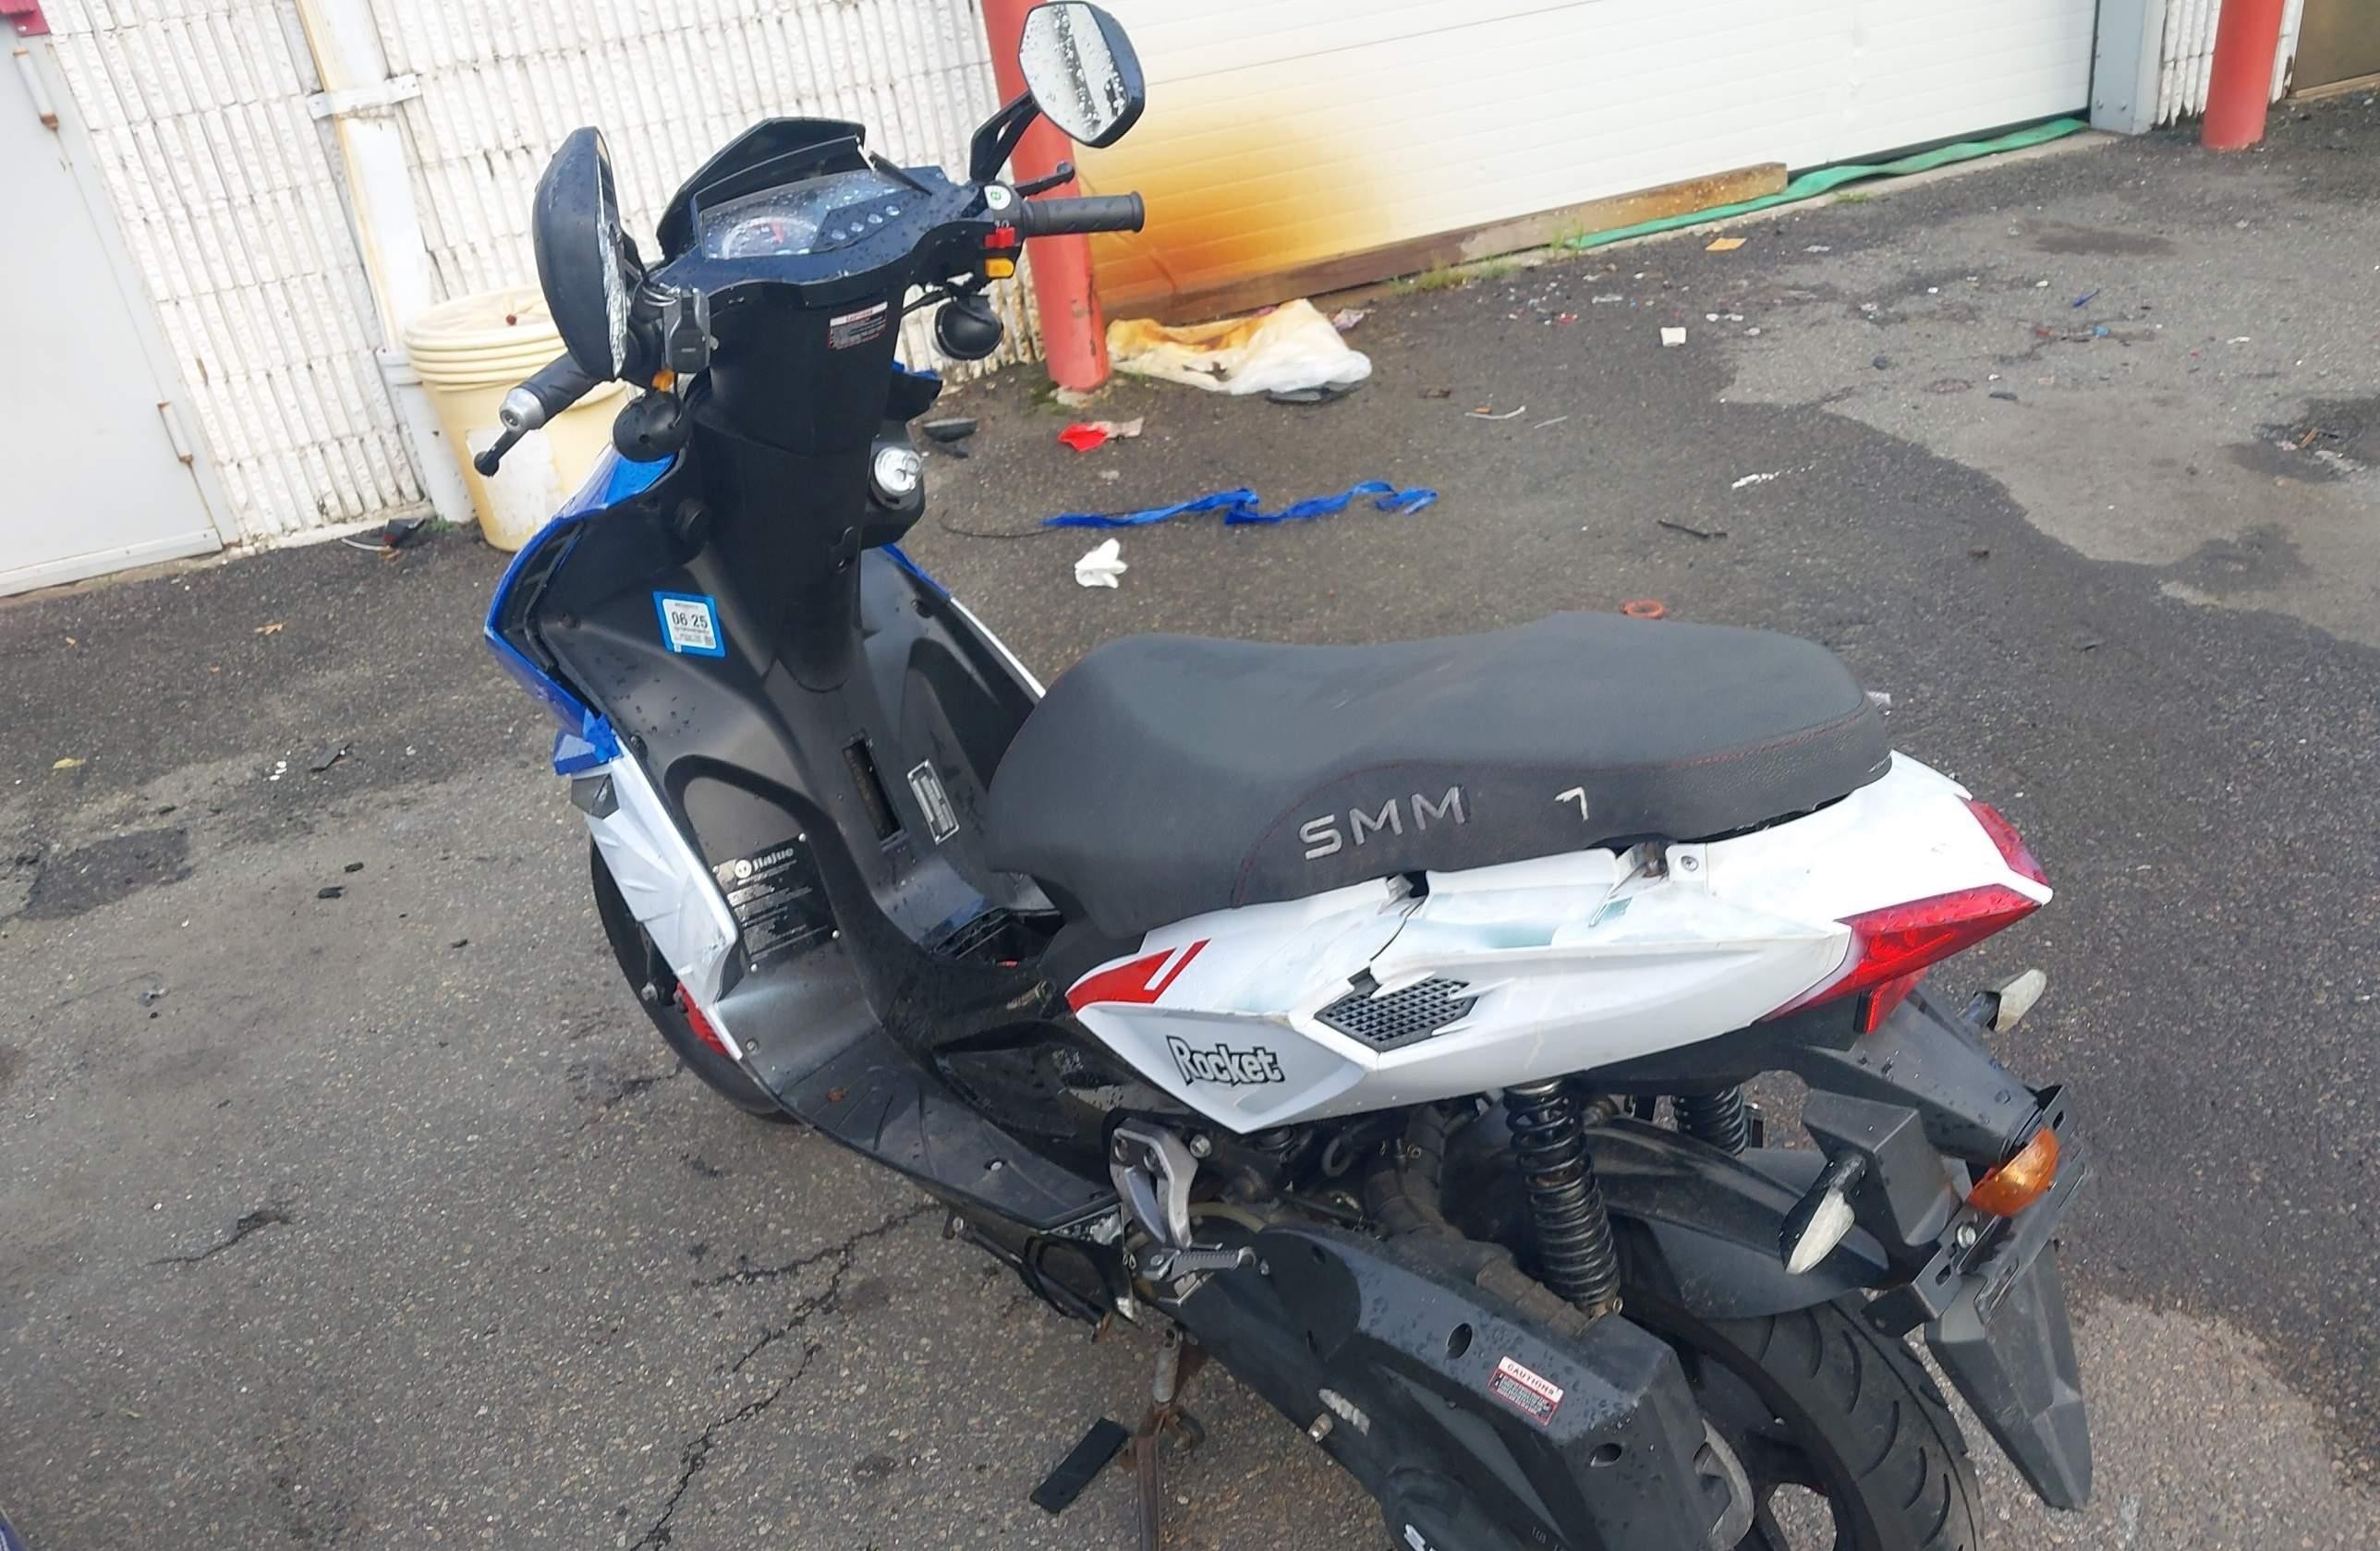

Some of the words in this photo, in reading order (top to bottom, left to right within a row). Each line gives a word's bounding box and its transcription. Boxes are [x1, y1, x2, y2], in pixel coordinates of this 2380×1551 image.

[672, 612, 687, 626] 06
[691, 614, 709, 629] 25
[1299, 786, 1466, 860] SMM
[1166, 1035, 1285, 1086] Rocket
